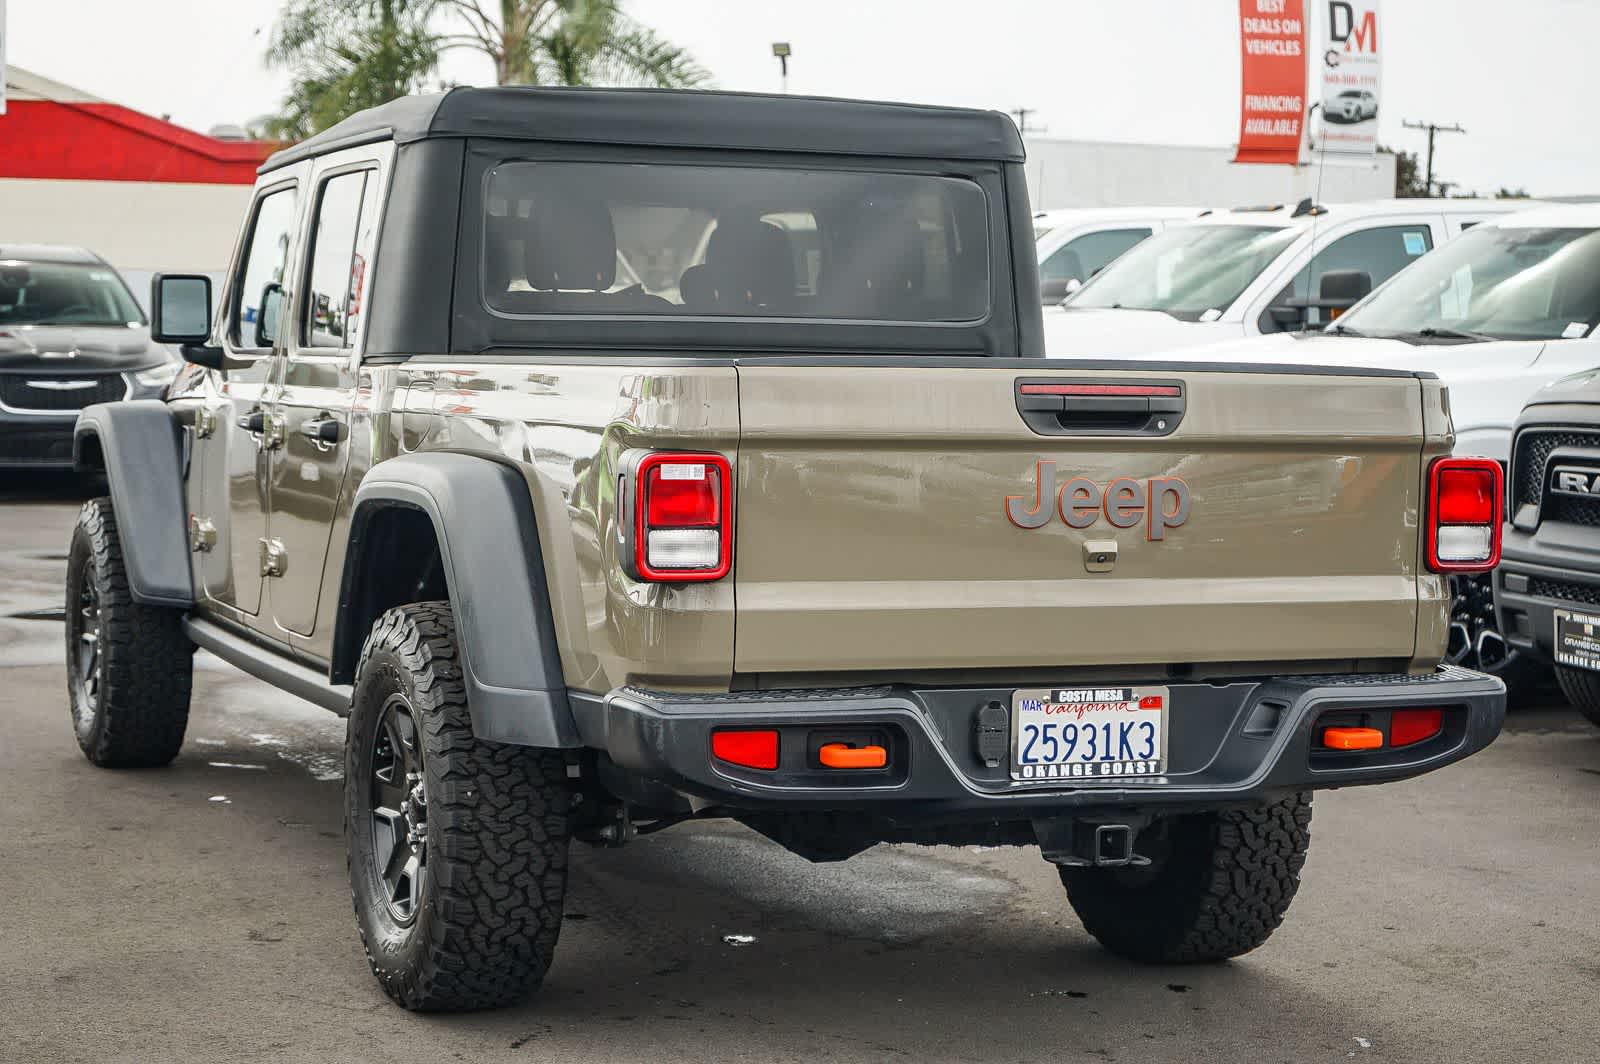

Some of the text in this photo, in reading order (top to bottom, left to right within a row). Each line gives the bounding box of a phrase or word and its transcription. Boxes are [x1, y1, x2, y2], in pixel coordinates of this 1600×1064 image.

[1256, 0, 1284, 12] BEST
[1243, 17, 1301, 34] DEALS ON
[1246, 39, 1300, 56] VEHICLES
[1245, 95, 1301, 113] FINANCING
[1245, 119, 1298, 136] AVAILABLE
[1005, 460, 1190, 541] Jeep
[1059, 689, 1123, 702] COSTA MESA
[1022, 699, 1042, 711] MAR
[1022, 721, 1155, 763] 25931K3
[1023, 761, 1157, 778] ORANGE COAST
